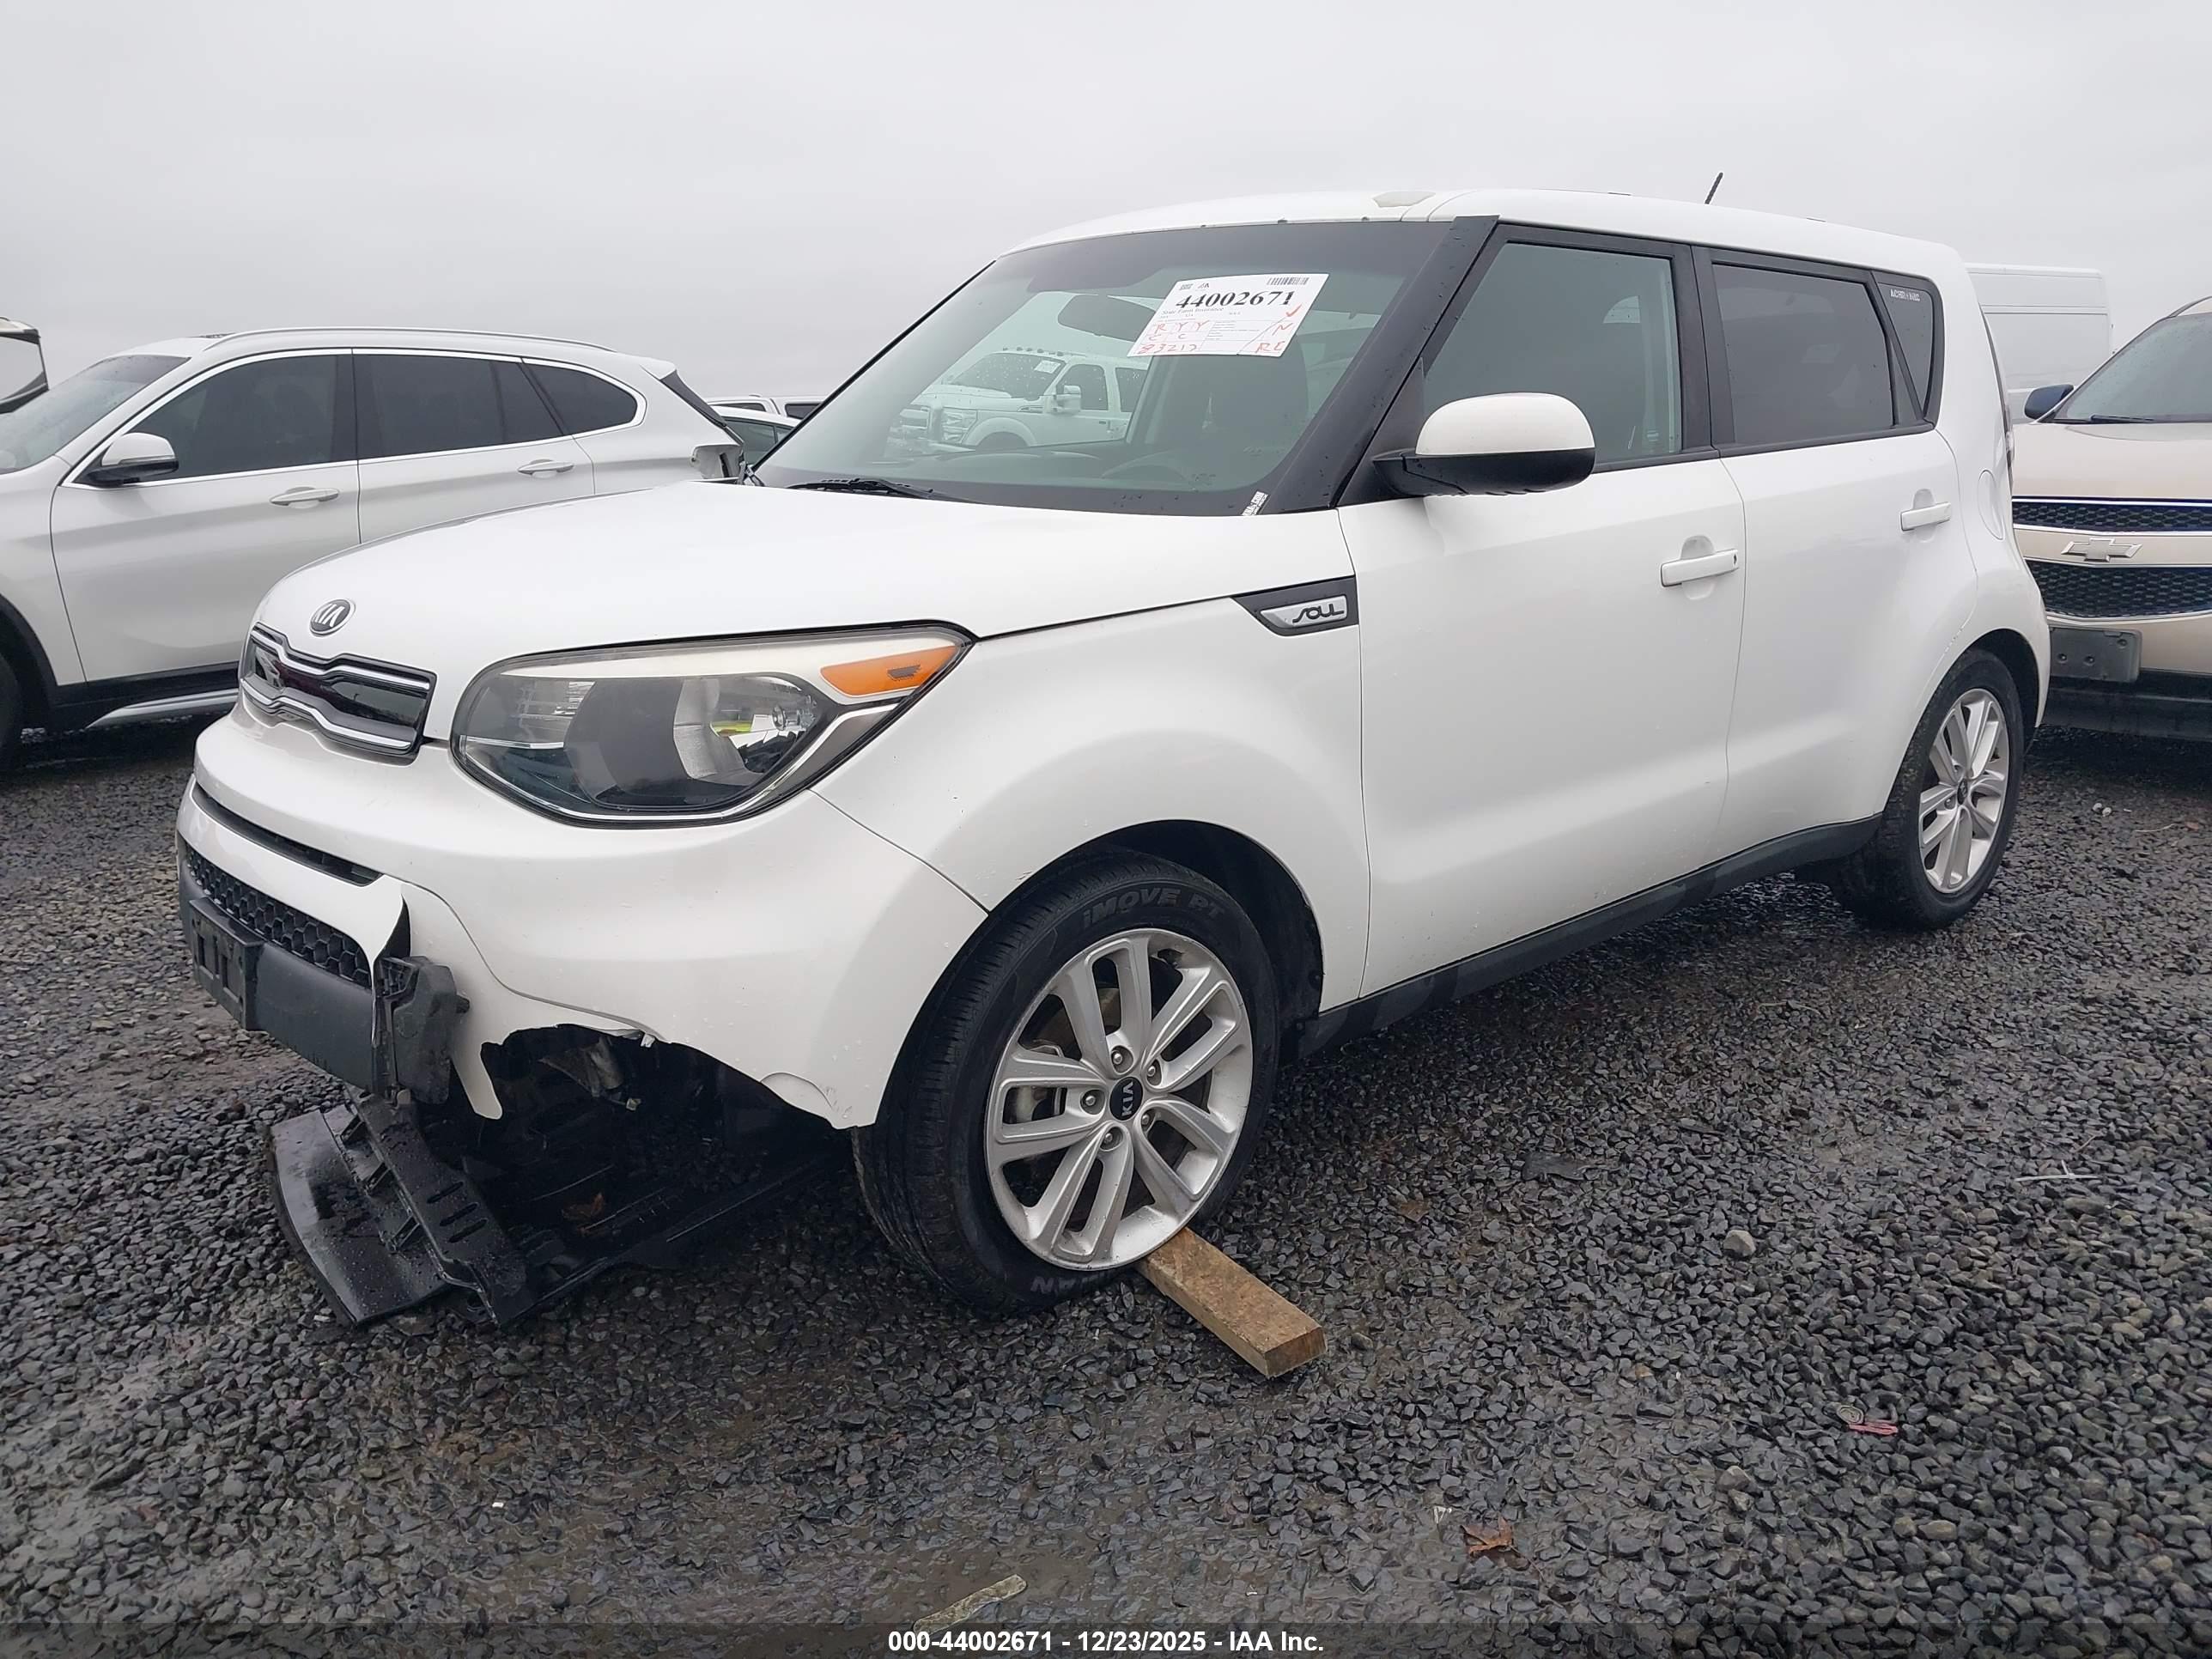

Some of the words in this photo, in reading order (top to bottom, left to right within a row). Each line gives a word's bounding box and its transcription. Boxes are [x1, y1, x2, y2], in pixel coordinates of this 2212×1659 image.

[1176, 291, 1294, 308] 44002671
[313, 603, 346, 628] KIA
[1291, 603, 1345, 623] SOUL
[1121, 1081, 1134, 1117] KIA
